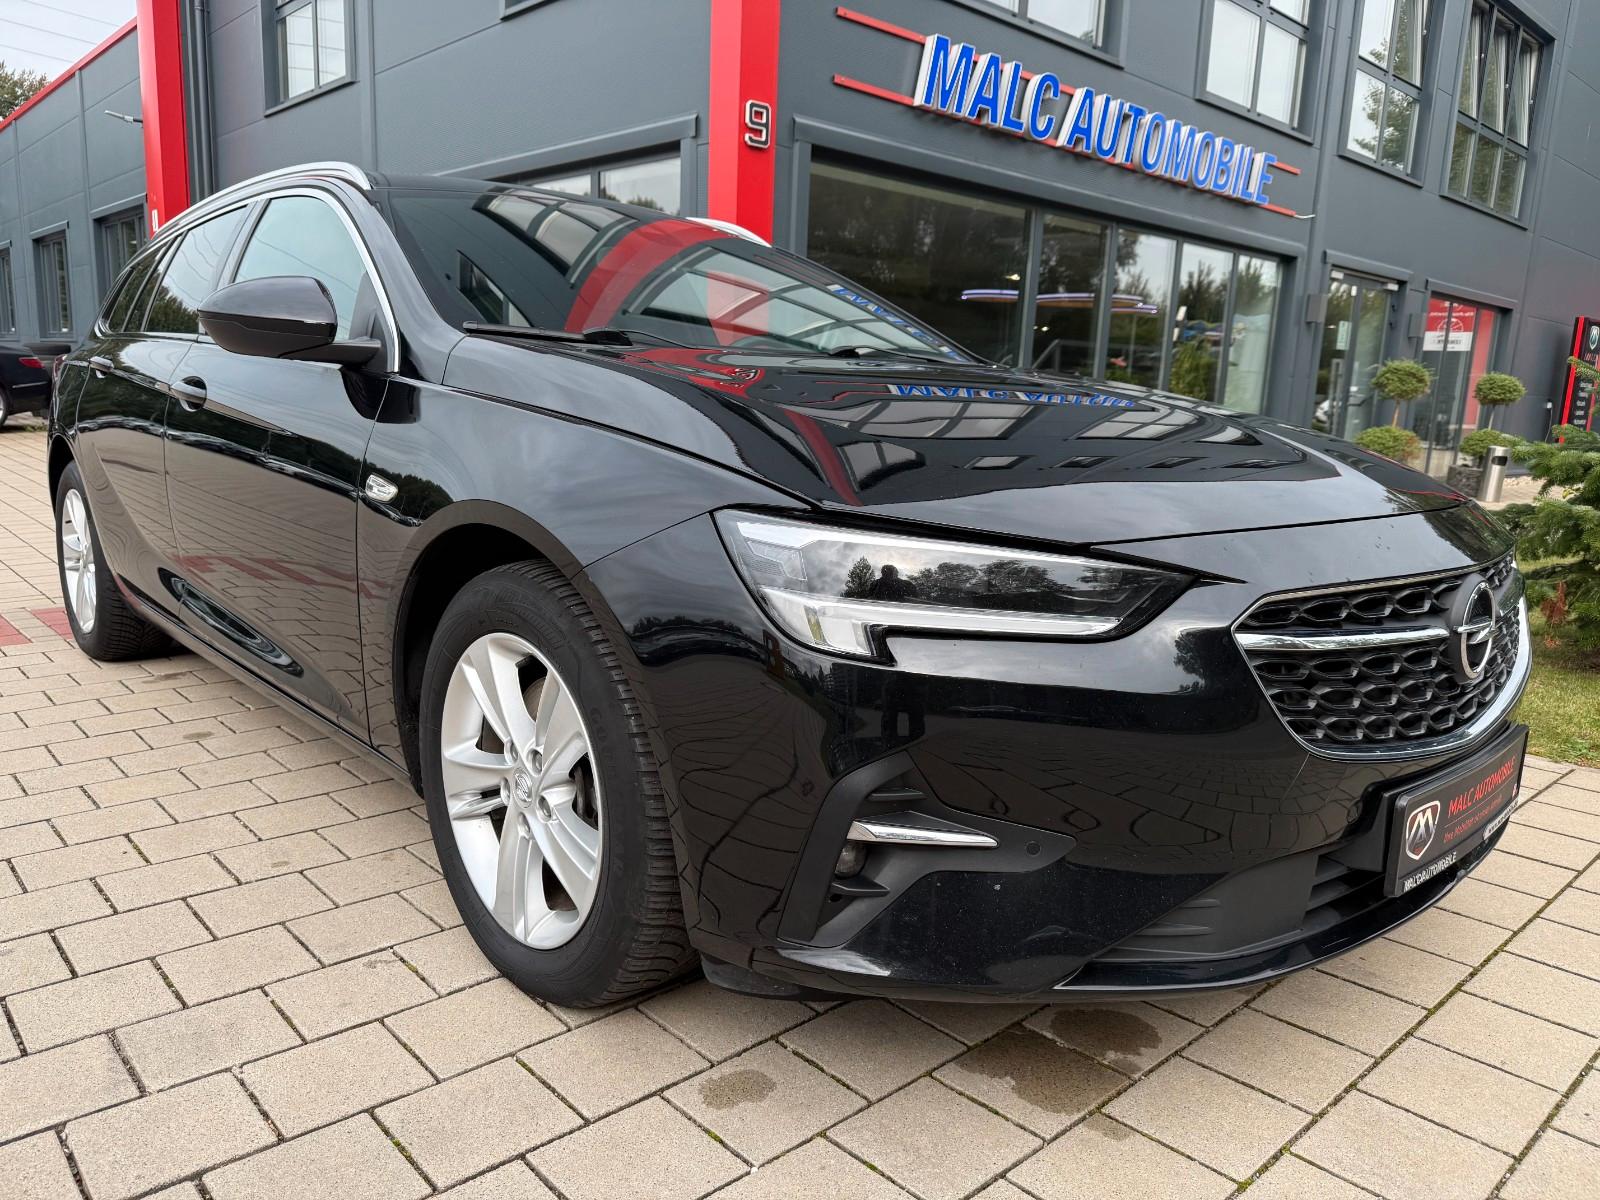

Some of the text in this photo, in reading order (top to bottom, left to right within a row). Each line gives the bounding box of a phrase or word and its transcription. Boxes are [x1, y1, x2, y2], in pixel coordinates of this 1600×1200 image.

[744, 99, 772, 149] 9
[916, 34, 1278, 205] MALC AUTOMOBILE
[1447, 790, 1474, 818] MALC
